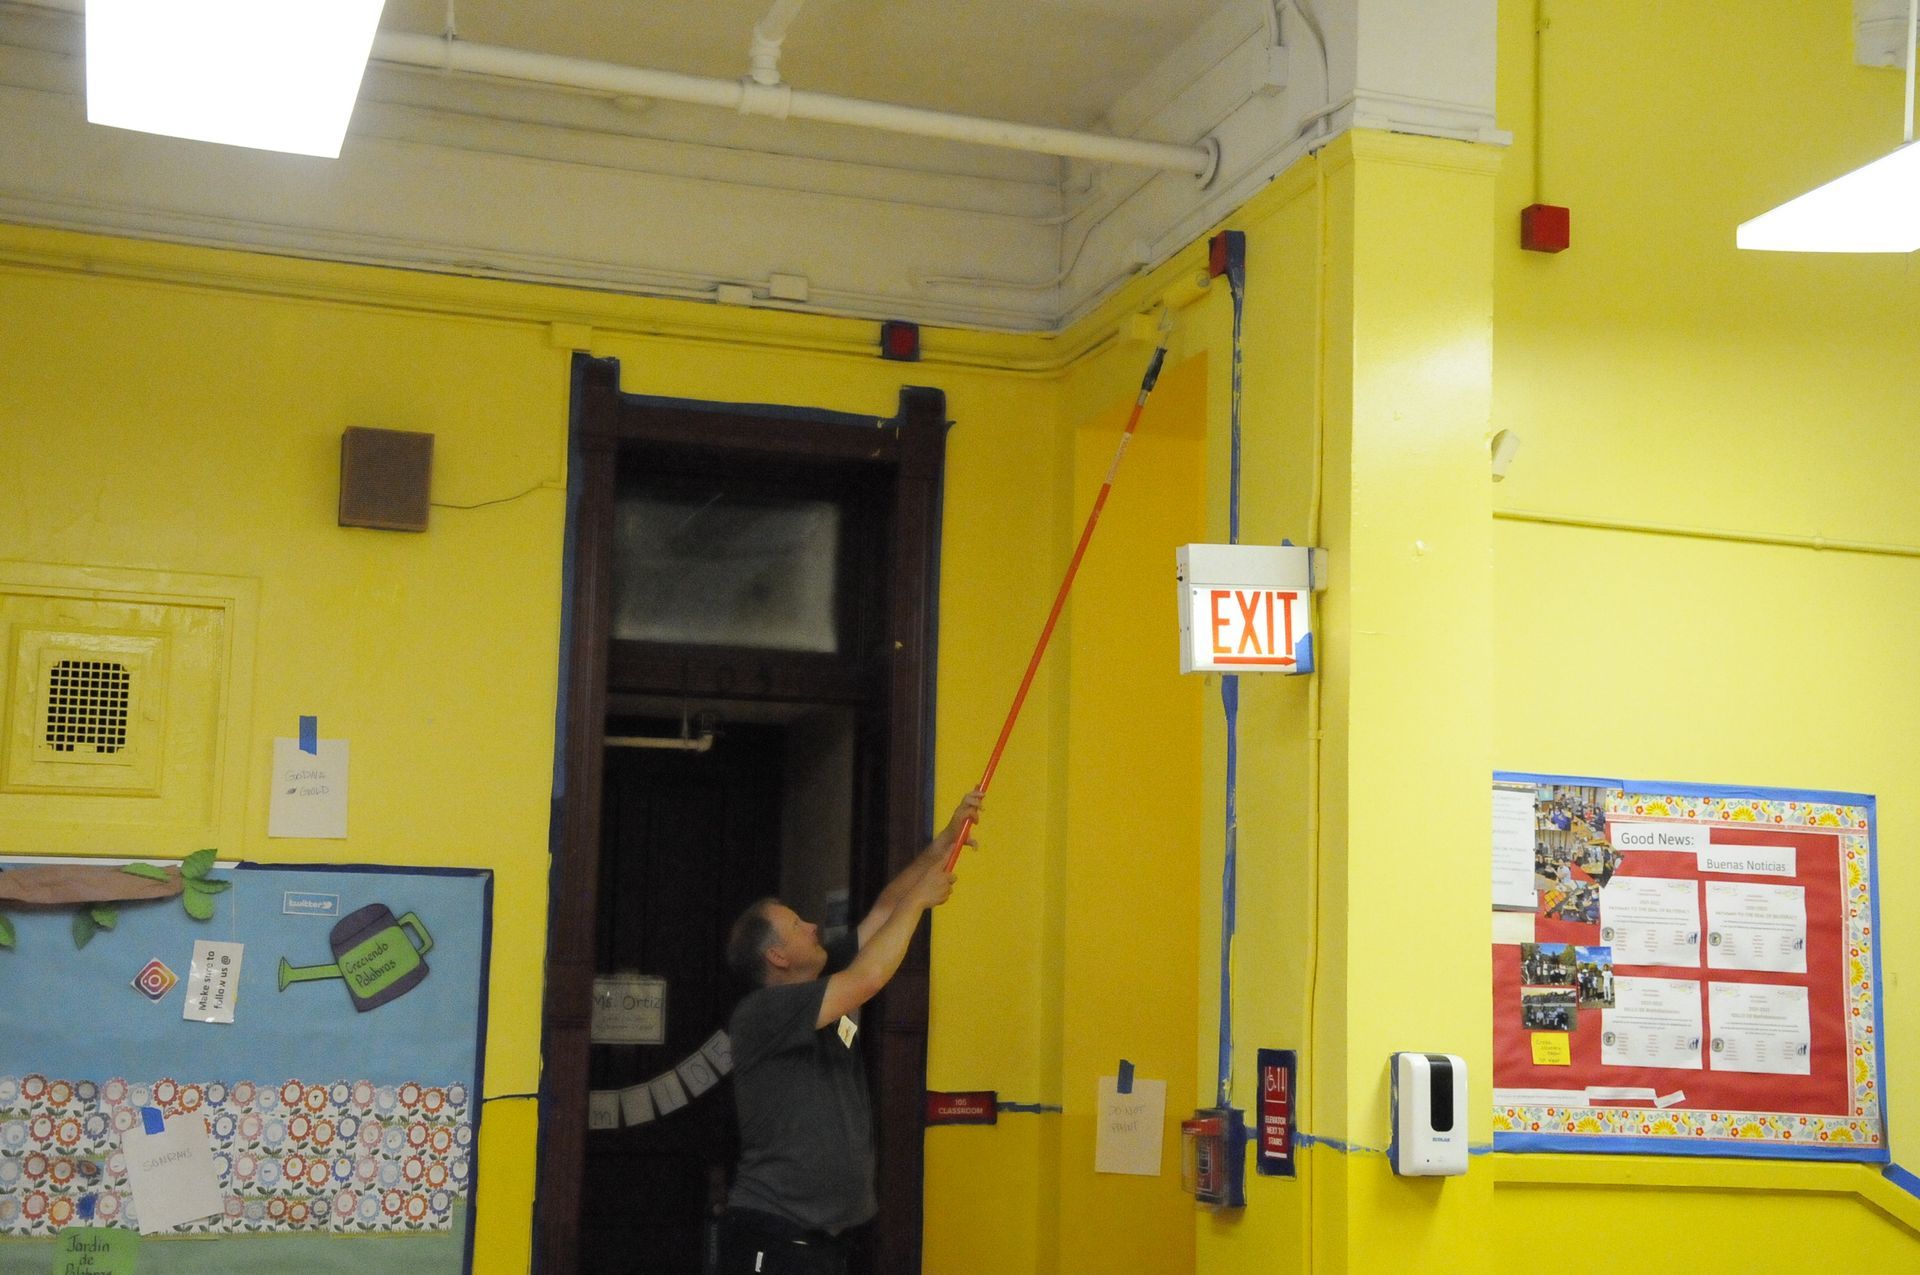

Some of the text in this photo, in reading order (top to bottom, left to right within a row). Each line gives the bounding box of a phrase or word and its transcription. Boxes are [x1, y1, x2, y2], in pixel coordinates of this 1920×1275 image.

[1210, 590, 1298, 656] EXIT
[1620, 832, 1695, 846] Good News:
[1706, 858, 1786, 872] Buenas Noticias
[345, 940, 389, 974] Creciendo
[198, 984, 210, 1011] Make
[206, 950, 215, 961] to
[355, 959, 397, 988] Palabras
[213, 955, 231, 1009] follow us @
[1264, 1115, 1287, 1126] ELEVATOR
[1278, 1127, 1285, 1136] TO
[1268, 1136, 1283, 1147] STAIRS
[79, 1254, 94, 1266] de
